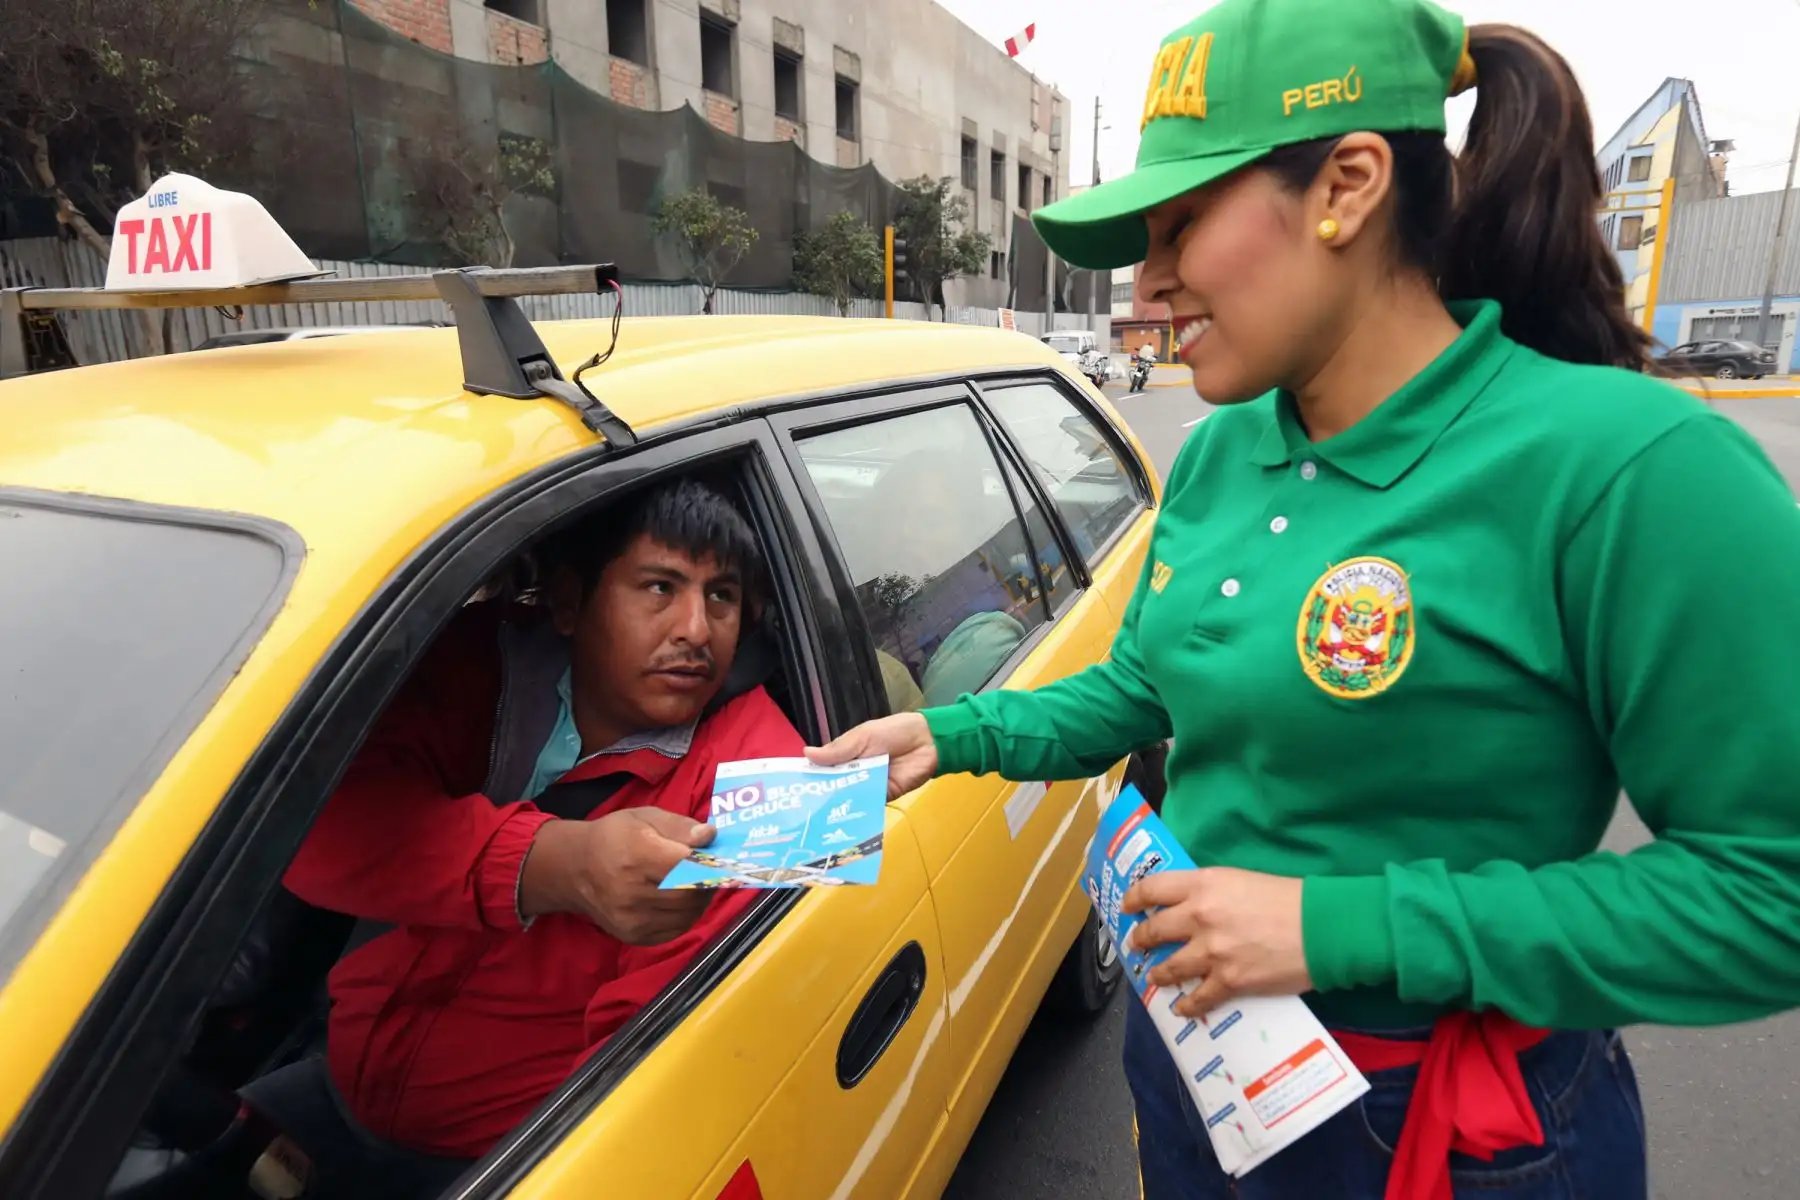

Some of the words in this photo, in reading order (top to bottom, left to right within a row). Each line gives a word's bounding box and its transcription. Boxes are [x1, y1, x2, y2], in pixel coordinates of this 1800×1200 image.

[1282, 65, 1362, 116] PERÚ
[148, 191, 178, 209] LIBRE
[119, 212, 211, 274] TAXI
[711, 786, 760, 816] NO
[766, 770, 870, 800] BLOQUEES
[715, 814, 736, 829] EL
[739, 796, 802, 822] CRUCE
